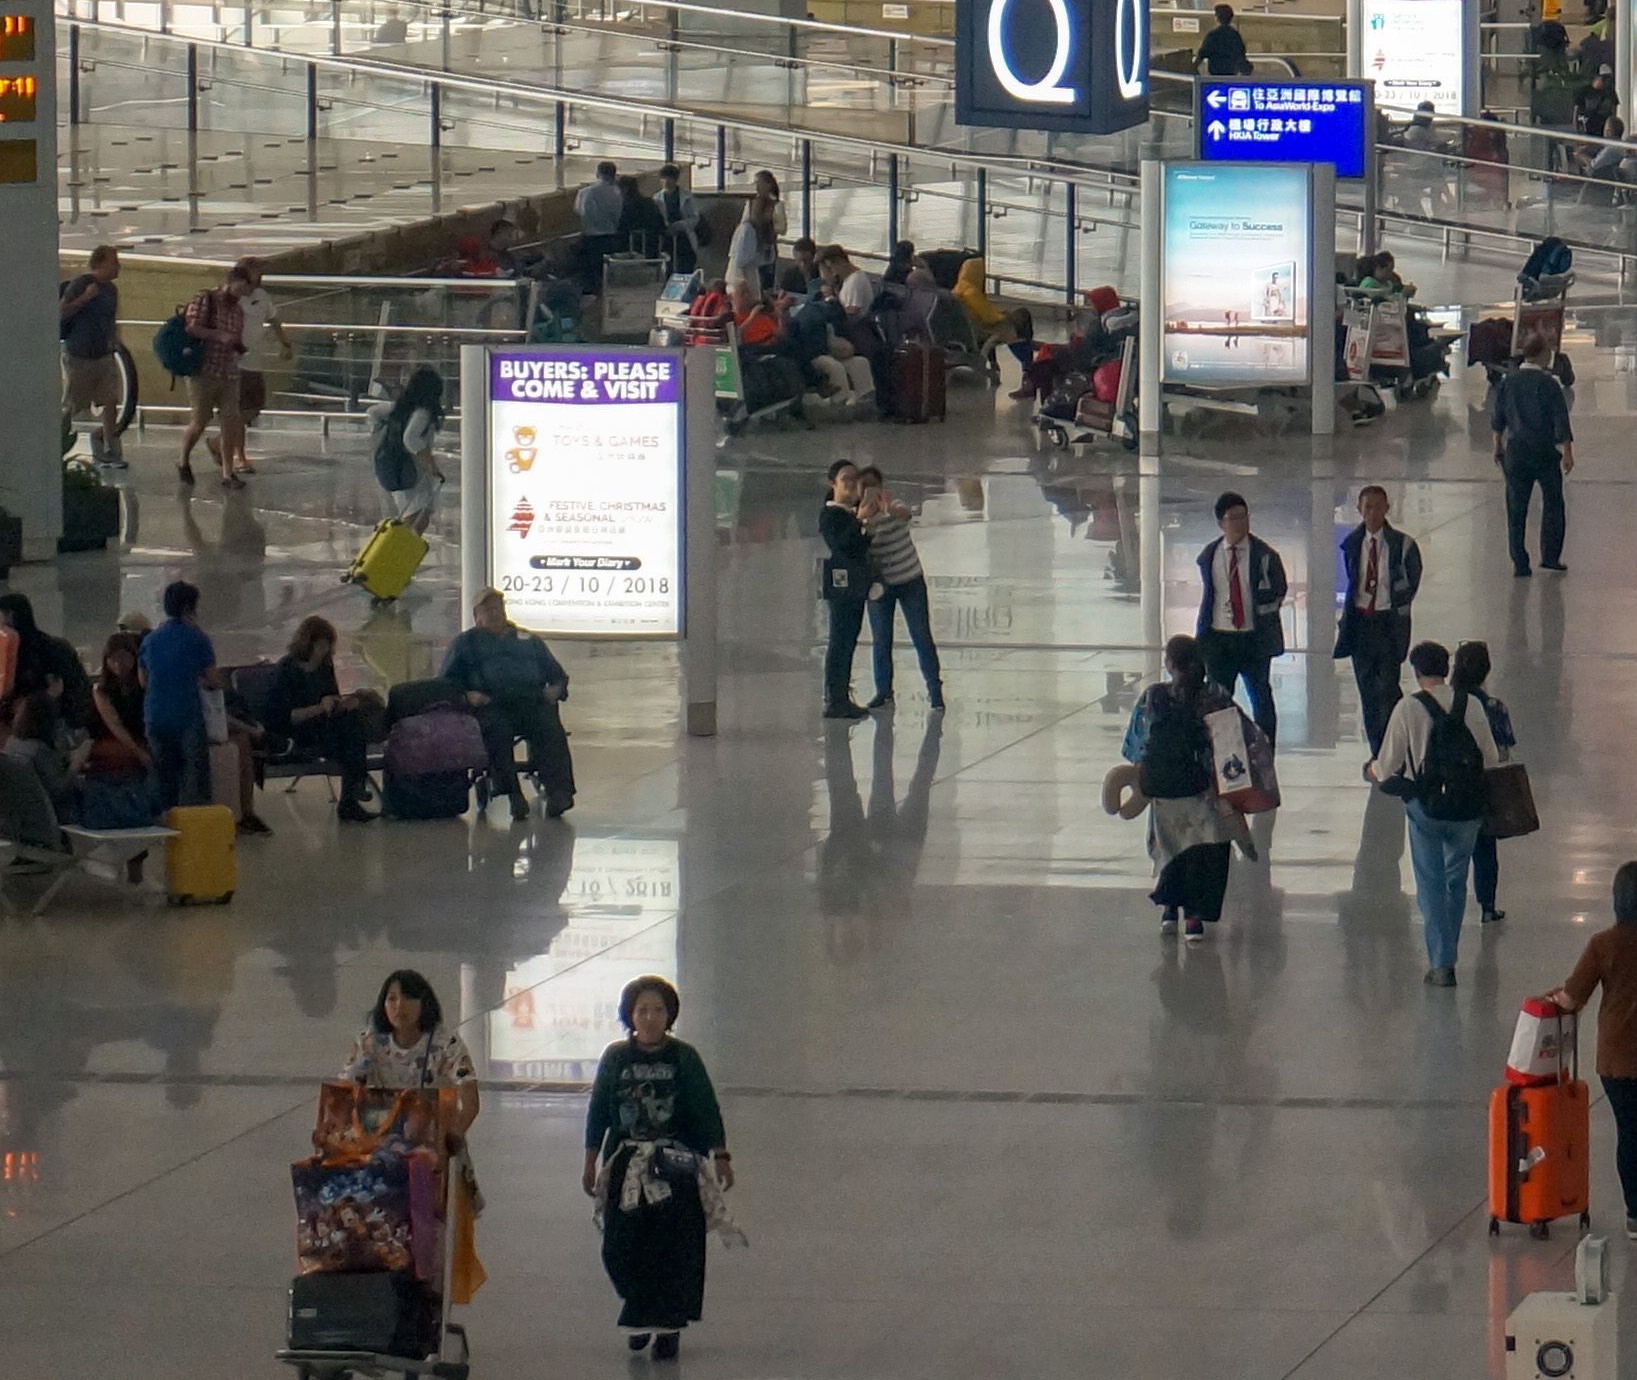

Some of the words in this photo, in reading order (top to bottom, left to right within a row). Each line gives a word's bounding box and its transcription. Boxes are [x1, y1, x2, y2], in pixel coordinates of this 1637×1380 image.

[1255, 102, 1264, 111] To
[1253, 131, 1280, 141] Tower
[1189, 221, 1228, 233] Gateway
[1231, 221, 1240, 231] to
[1242, 221, 1283, 232] Success
[500, 361, 588, 380] BUYERS:
[594, 362, 670, 380] PLEASE
[511, 380, 575, 398] COME
[580, 381, 599, 399] &
[604, 381, 659, 400] VISIT
[553, 435, 589, 447] TOYS
[594, 436, 603, 447] &
[608, 435, 659, 448] GAMES
[599, 502, 666, 512] CHRISTMAS
[554, 513, 616, 523] SEASONAL
[546, 557, 571, 567] Mark
[573, 557, 594, 567] Your
[596, 557, 623, 569] Diary
[501, 576, 553, 592] 20-23
[580, 577, 600, 593] 10
[624, 577, 669, 594] 2018
